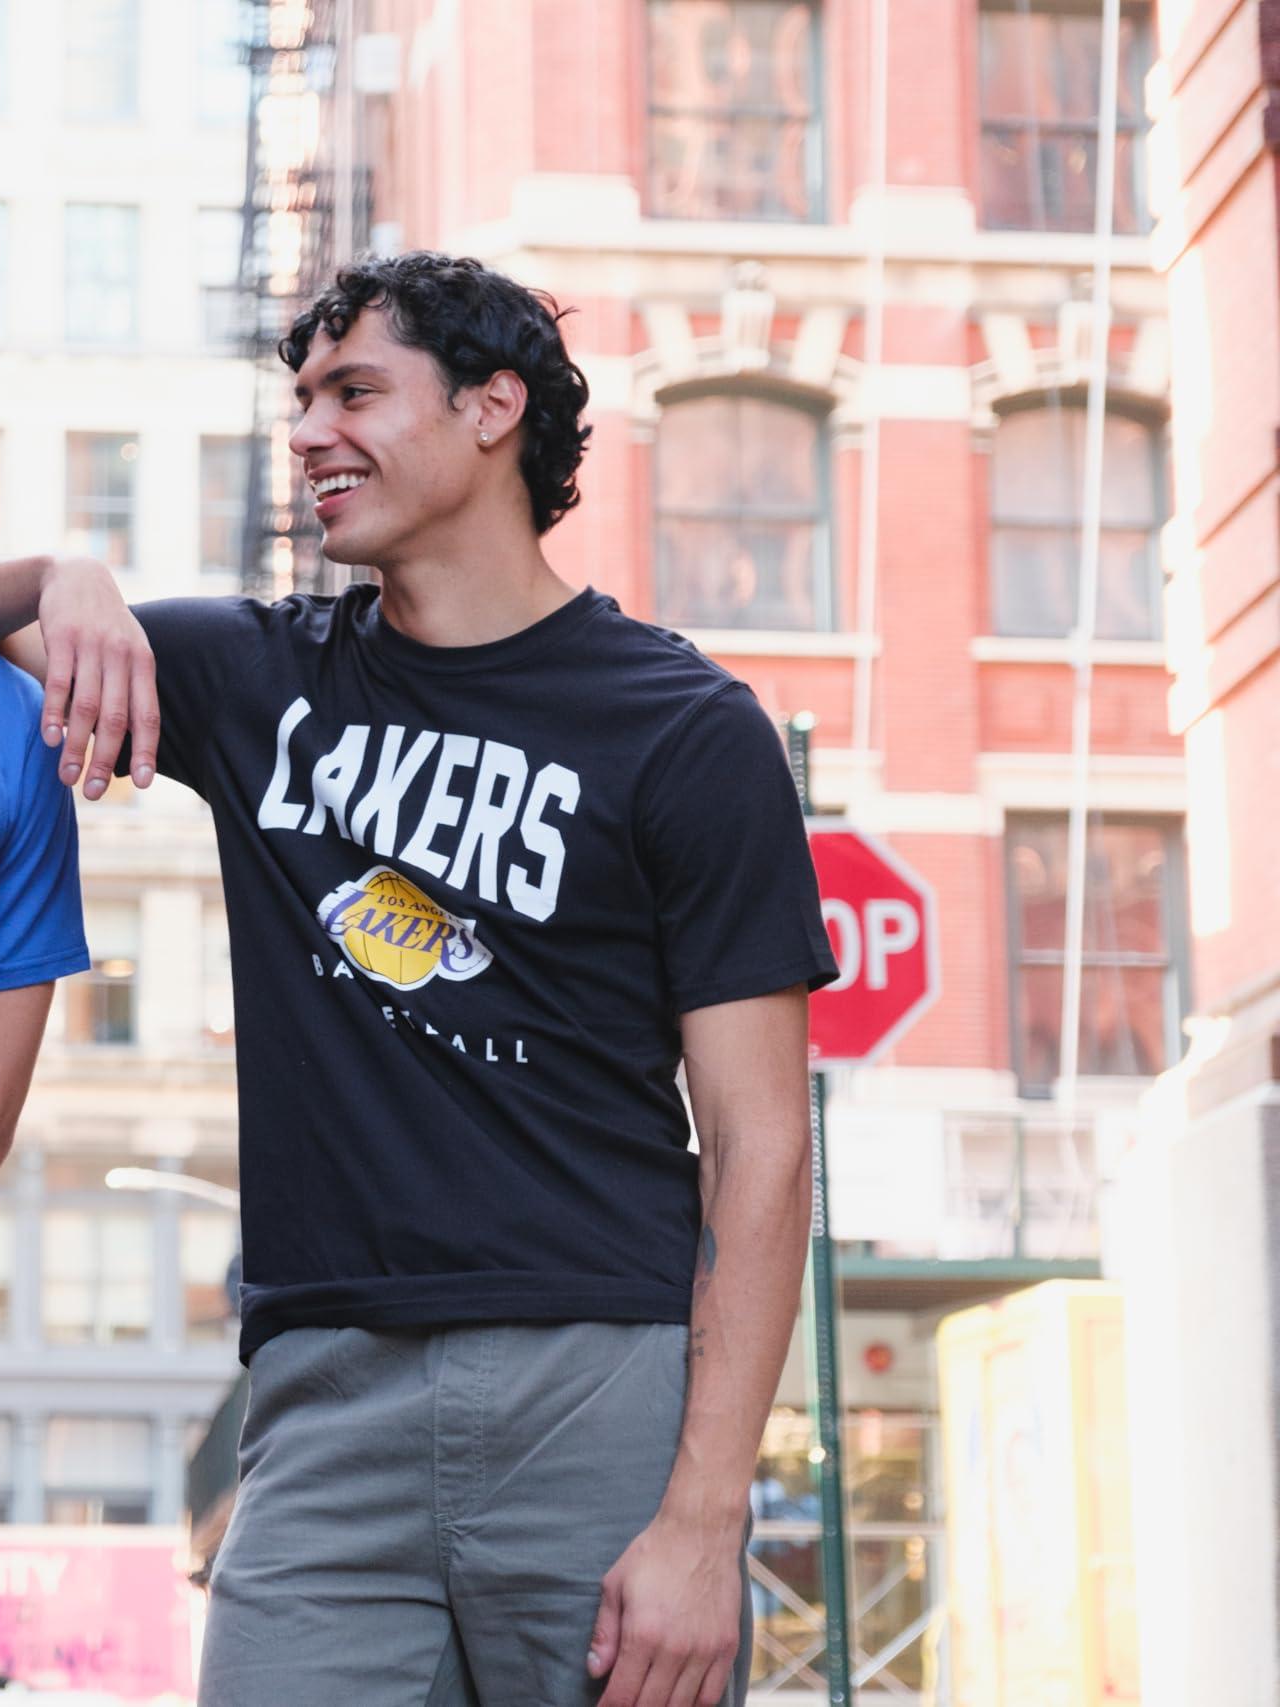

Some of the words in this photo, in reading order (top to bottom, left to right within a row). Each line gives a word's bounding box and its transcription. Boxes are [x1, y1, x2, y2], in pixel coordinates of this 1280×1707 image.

[257, 696, 581, 923] LAKERS
[324, 888, 478, 973] LAKERS
[377, 895, 406, 907] LOS
[821, 898, 920, 991] OP
